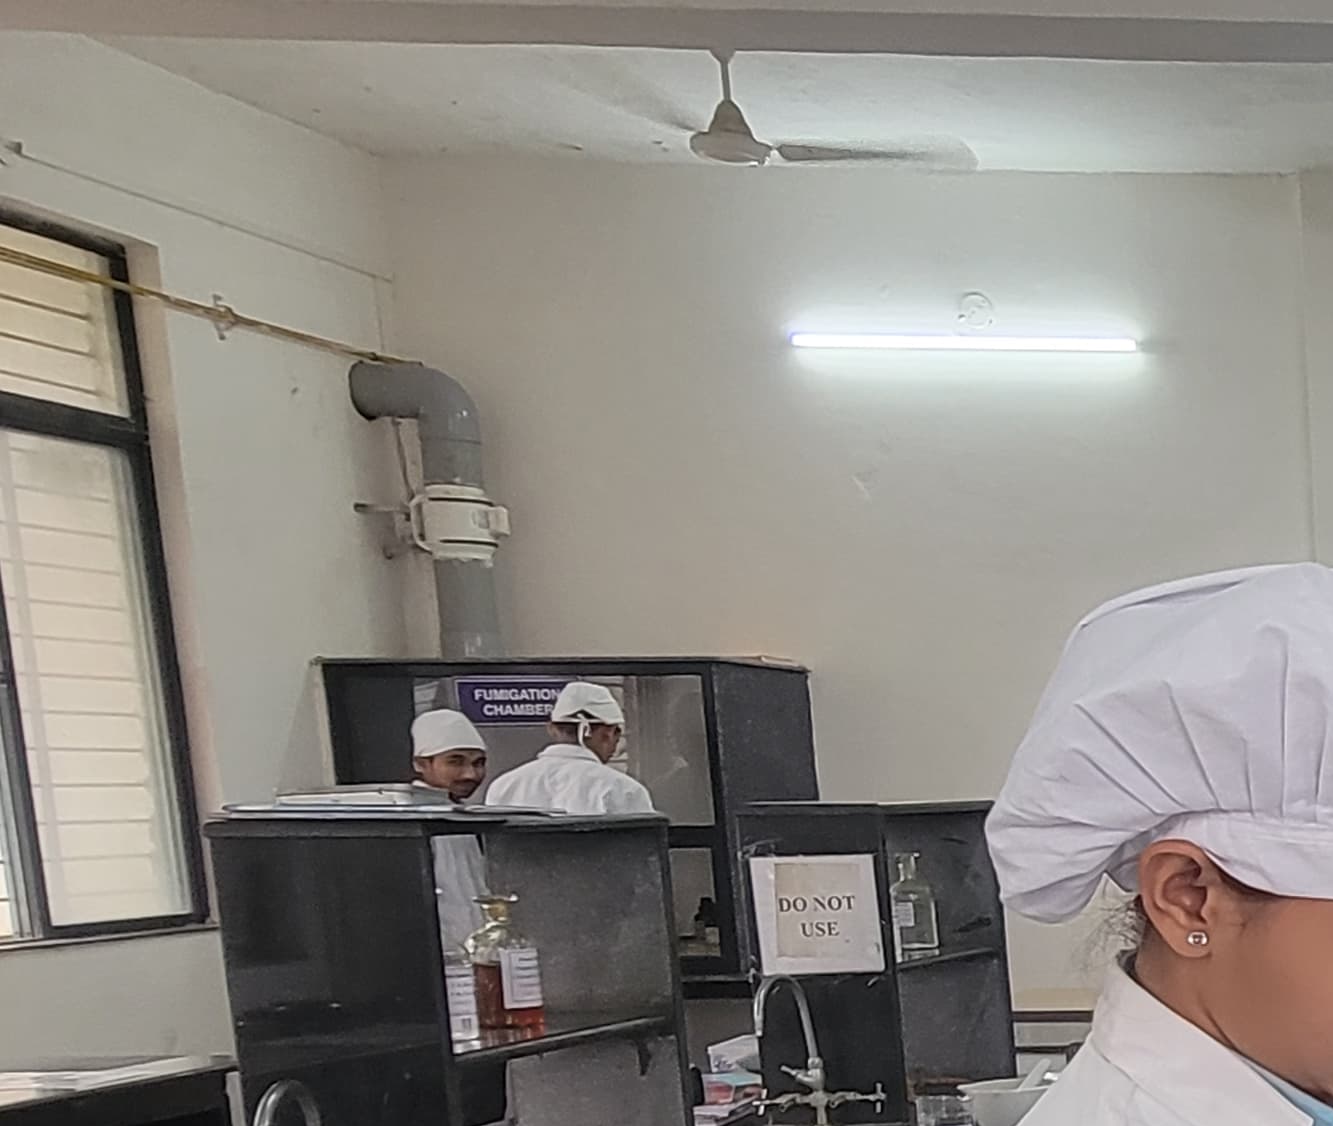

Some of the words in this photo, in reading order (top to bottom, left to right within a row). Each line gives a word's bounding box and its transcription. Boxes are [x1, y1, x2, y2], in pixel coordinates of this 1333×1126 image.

[473, 688, 561, 701] FUMIGATION
[482, 703, 554, 716] CHAMBER
[778, 896, 808, 912] DO
[813, 895, 856, 911] NOT
[800, 921, 840, 937] USE
